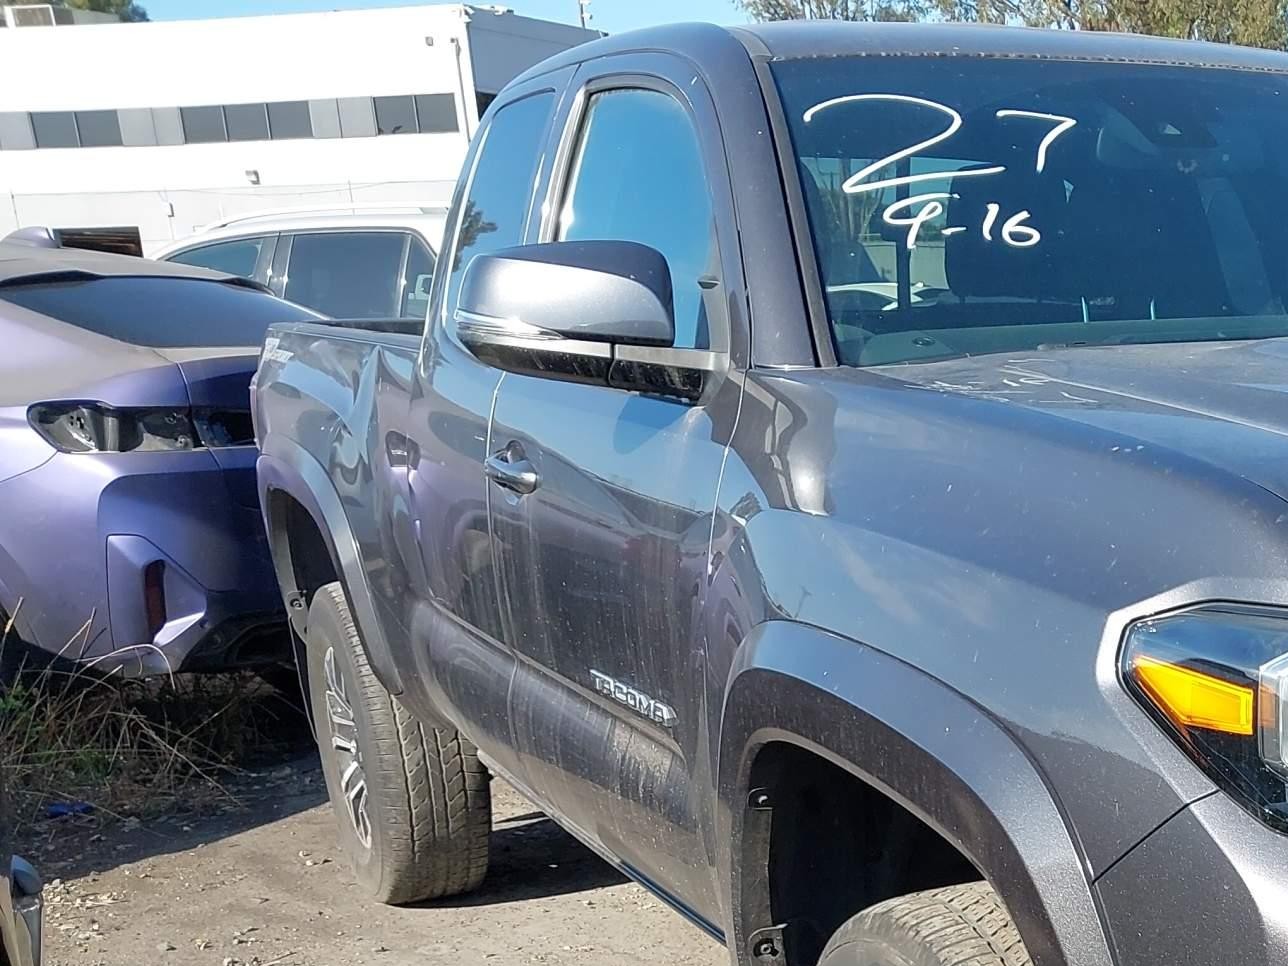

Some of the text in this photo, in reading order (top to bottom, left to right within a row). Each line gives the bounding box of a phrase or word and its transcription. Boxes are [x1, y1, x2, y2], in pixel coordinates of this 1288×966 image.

[802, 93, 1078, 193] 27
[882, 191, 1041, 250] 9-16
[589, 668, 679, 727] TACOMA
